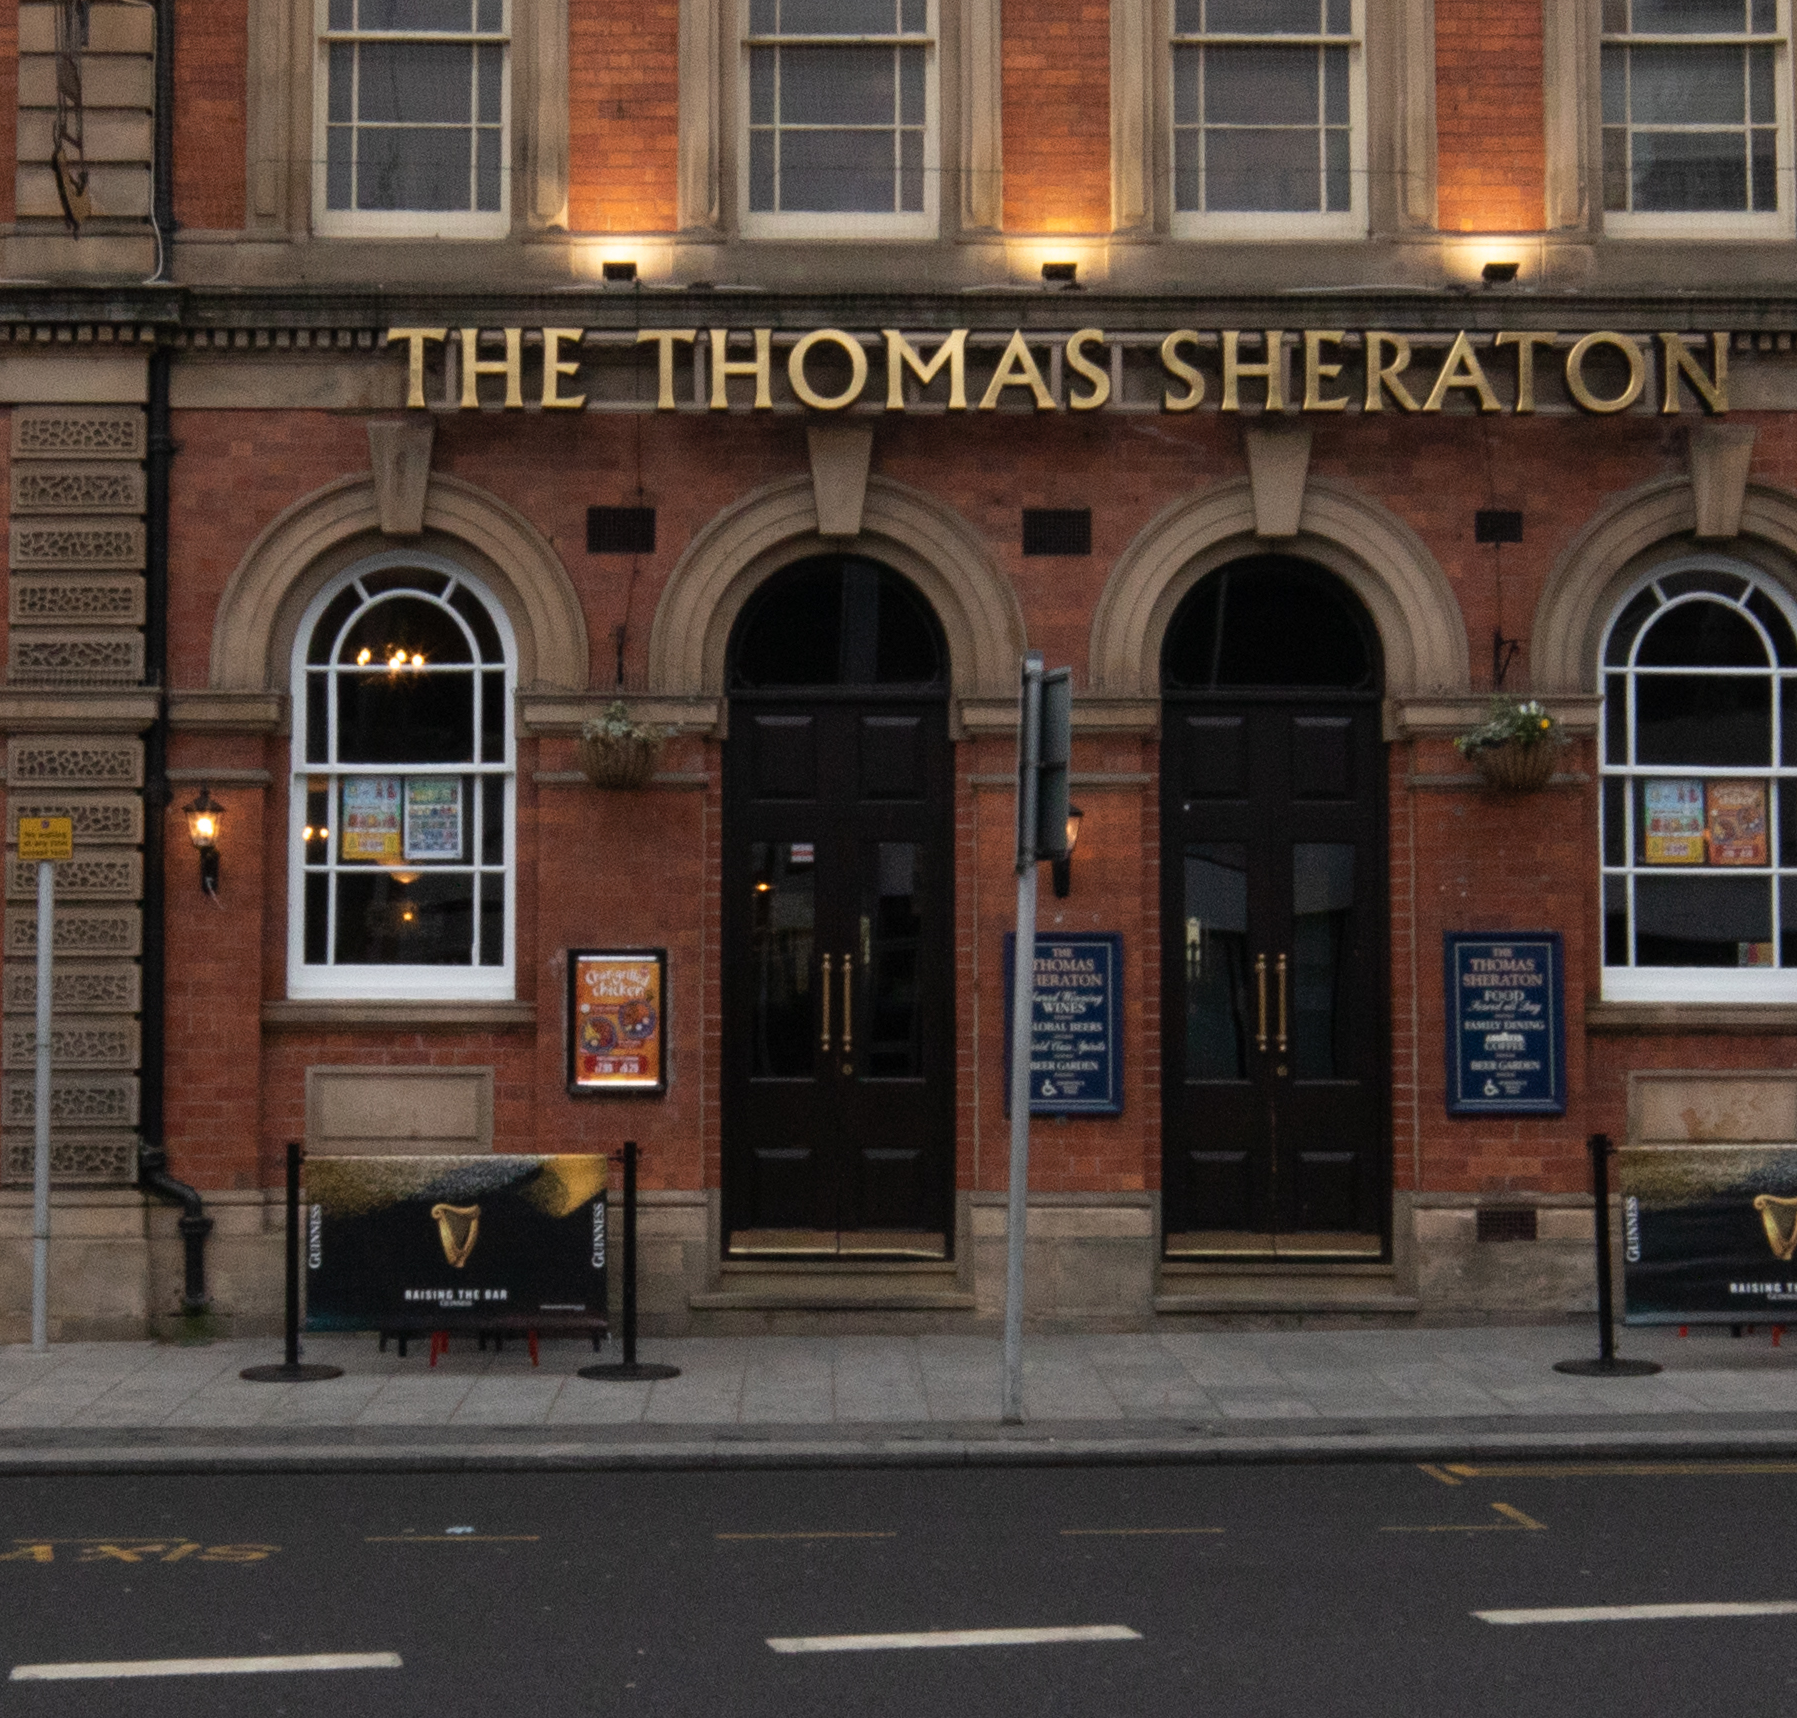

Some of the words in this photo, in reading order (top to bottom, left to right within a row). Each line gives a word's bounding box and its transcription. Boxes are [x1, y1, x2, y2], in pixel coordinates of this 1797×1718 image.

[387, 327, 587, 409] THE
[637, 327, 1110, 410] THOMAS
[1162, 328, 1730, 414] SHERATON
[1052, 948, 1073, 957] THE
[1492, 948, 1513, 957] THE
[1033, 958, 1095, 972] THOMAS
[1469, 958, 1536, 972] THOMAS
[1463, 973, 1543, 987] SHERATON
[1484, 990, 1525, 1002] FOOD
[1042, 1002, 1087, 1014] WINES
[1032, 1022, 1067, 1032] LOBAL
[1069, 1022, 1103, 1032] BEERS
[1464, 1020, 1502, 1031] FAMILY
[1504, 1020, 1545, 1031] DINING
[1484, 1041, 1525, 1051] COFFEE
[1056, 1061, 1099, 1071] GARDEN
[1470, 1060, 1497, 1071] BEER
[1498, 1060, 1541, 1071] GARDEN
[1626, 1196, 1640, 1262] GUINNESS
[308, 1204, 323, 1269] GUINNESS
[592, 1203, 606, 1268] GUINNESS
[1730, 1282, 1782, 1294] RAISING
[404, 1289, 454, 1301] RAISING
[458, 1289, 480, 1301] THE
[484, 1289, 508, 1301] BAR
